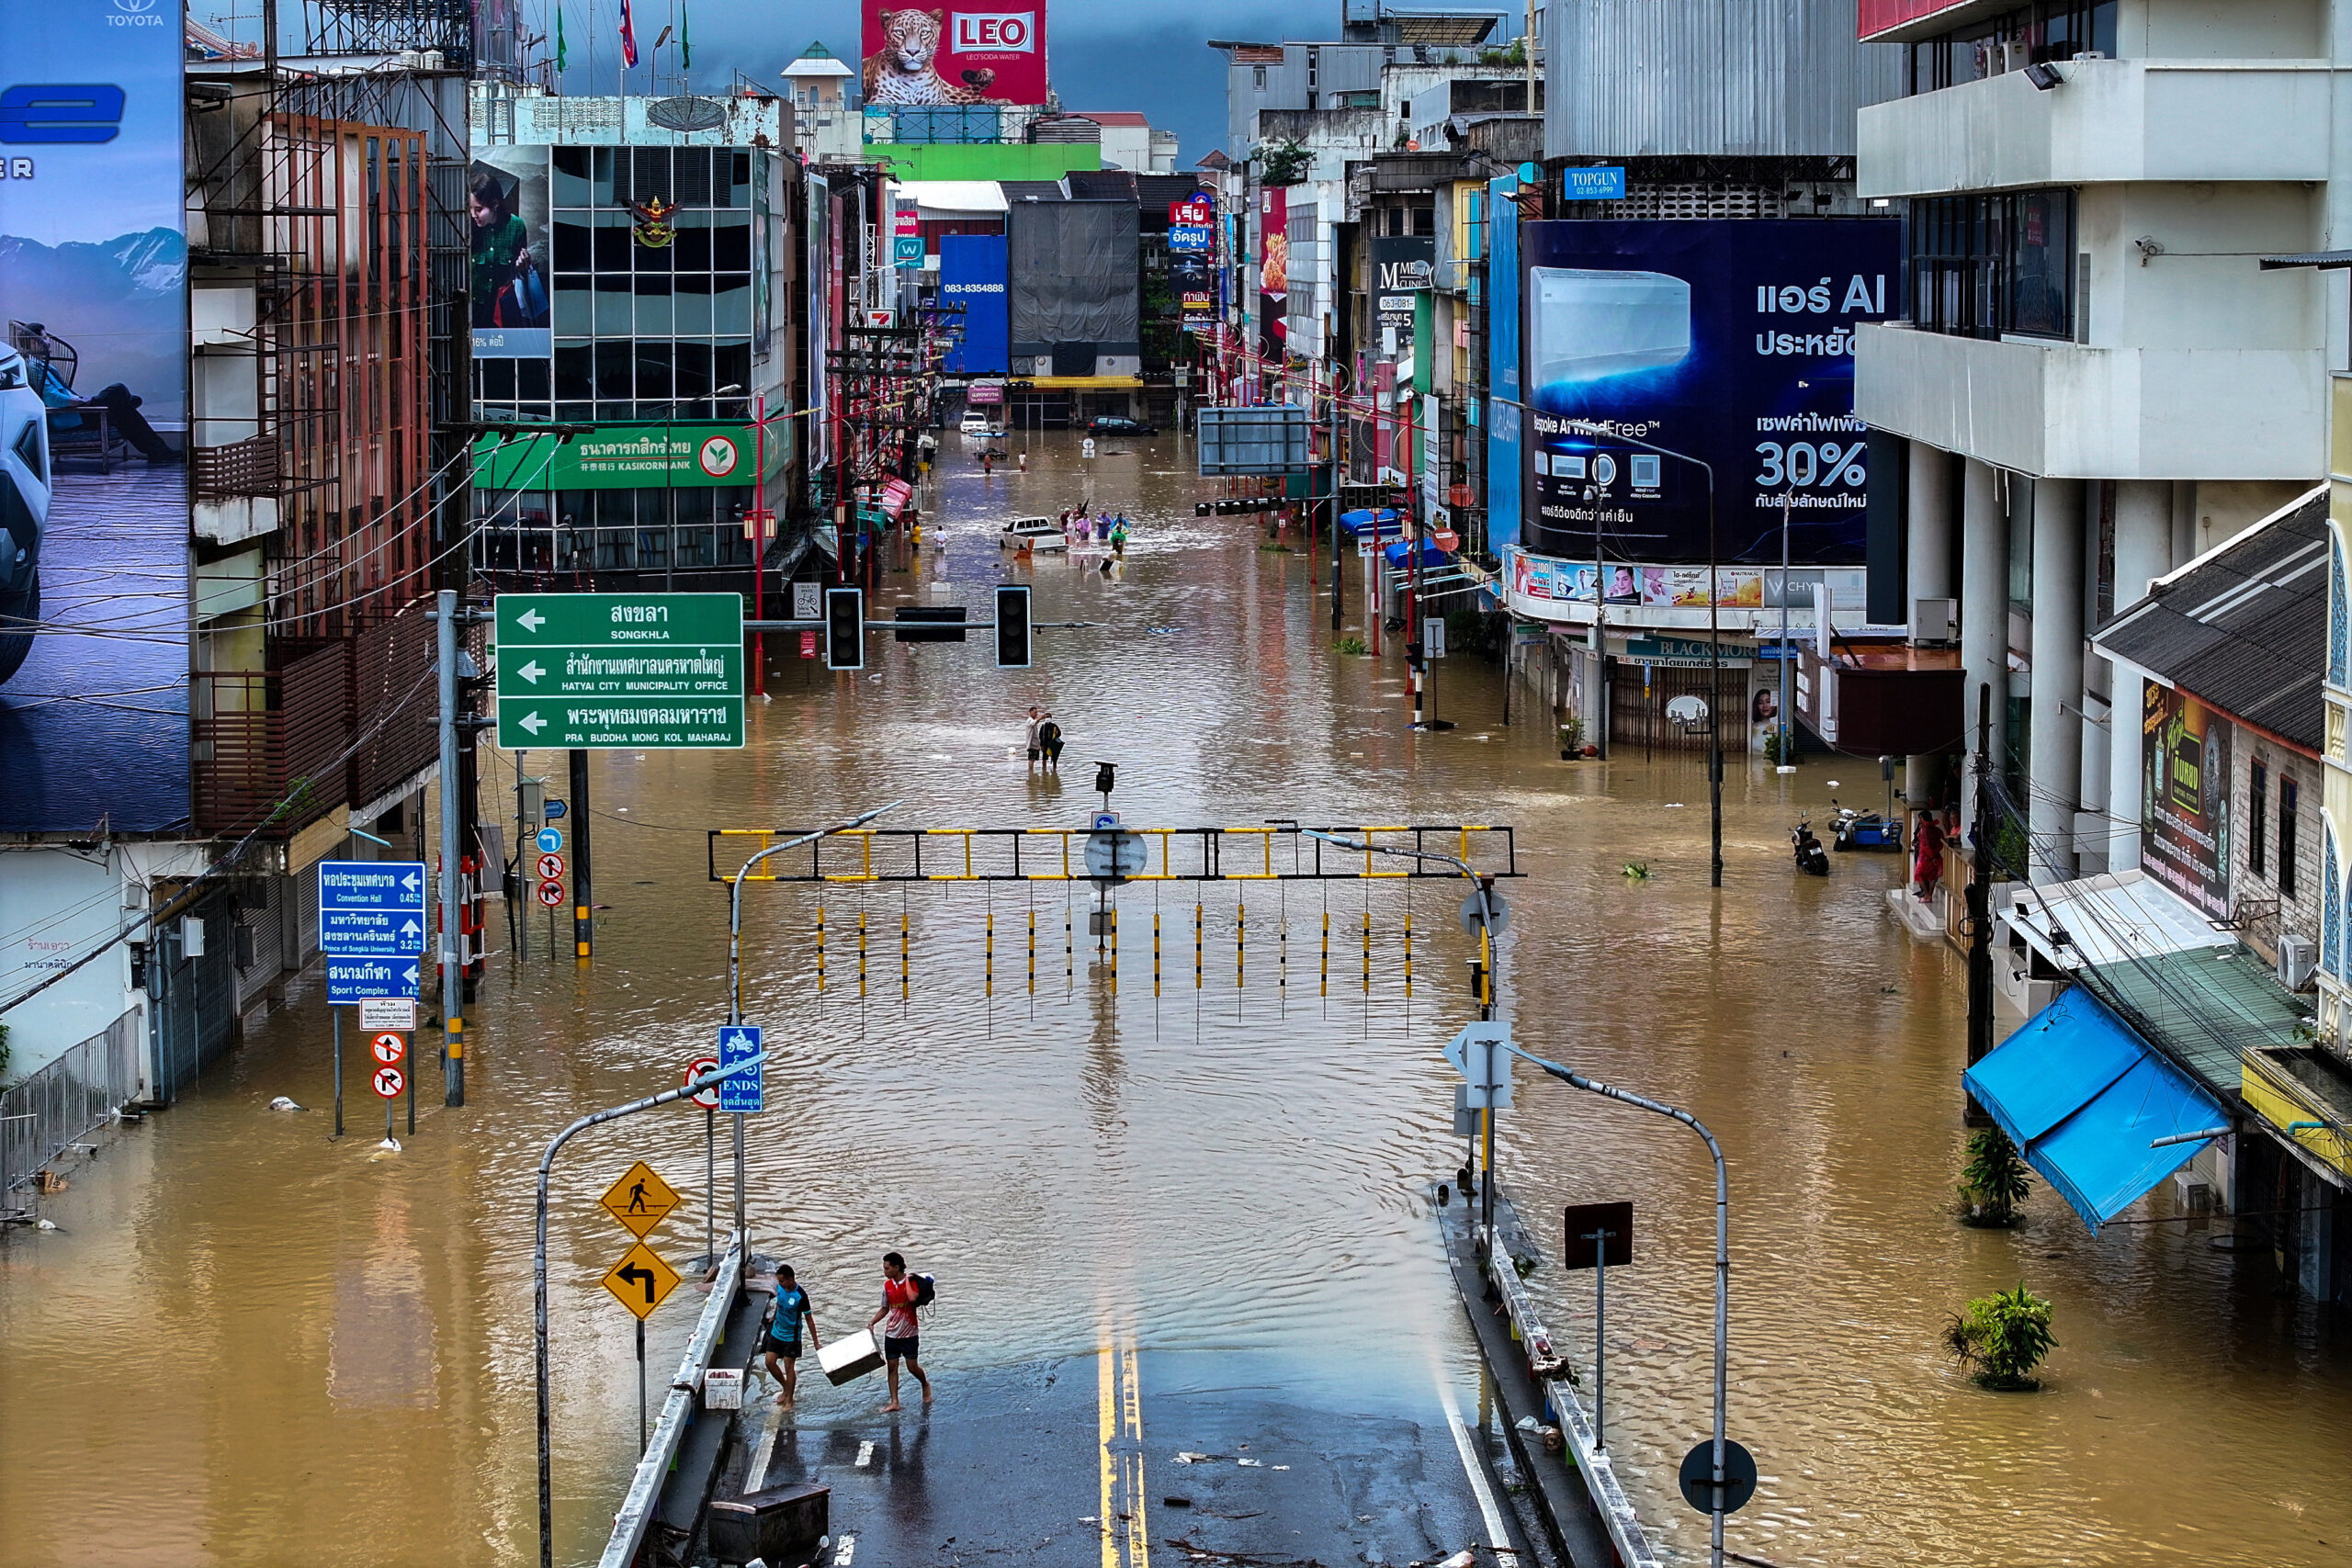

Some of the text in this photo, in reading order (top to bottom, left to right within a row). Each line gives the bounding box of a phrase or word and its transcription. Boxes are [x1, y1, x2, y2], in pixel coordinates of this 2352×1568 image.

[107, 16, 164, 27] TOYOTA
[959, 17, 1028, 48] LEO
[0, 159, 33, 177] R
[1571, 172, 1617, 186] TOPGUN
[1172, 230, 1205, 246] อัดรูป
[944, 283, 1004, 293] 083-8354888
[1757, 275, 1885, 313] แอร์ AI
[1533, 414, 1558, 436] Bespoke
[1755, 442, 1866, 487] 30%
[611, 605, 668, 623] สงขลา
[611, 630, 670, 639] SONGKHLA
[566, 649, 724, 679] สำนักงานเทศบาลนครหาดใหญ่
[561, 682, 729, 691] HATYAI CITY MUNICIPALITY OFFICE
[567, 705, 727, 729] พระพุทธมงคลมหาราช
[565, 734, 731, 743] PRA BUDDHA MONG KOL MAHARAJ
[323, 872, 395, 893] หอประชุมเทศบาล
[336, 894, 382, 903] Convention Hall
[400, 893, 413, 903] 0.45
[330, 913, 389, 926] มหาวิทยาลัย
[323, 930, 396, 942] สงขลานครินทร์
[348, 945, 369, 953] Songkla
[400, 940, 413, 950] 3.2
[329, 962, 391, 980] สนามกีฬา
[331, 986, 389, 996] Sport Complex
[401, 986, 413, 996] 1.4
[723, 1079, 759, 1090] ENDS
[722, 1093, 760, 1109] จุดสิ้นสุด
